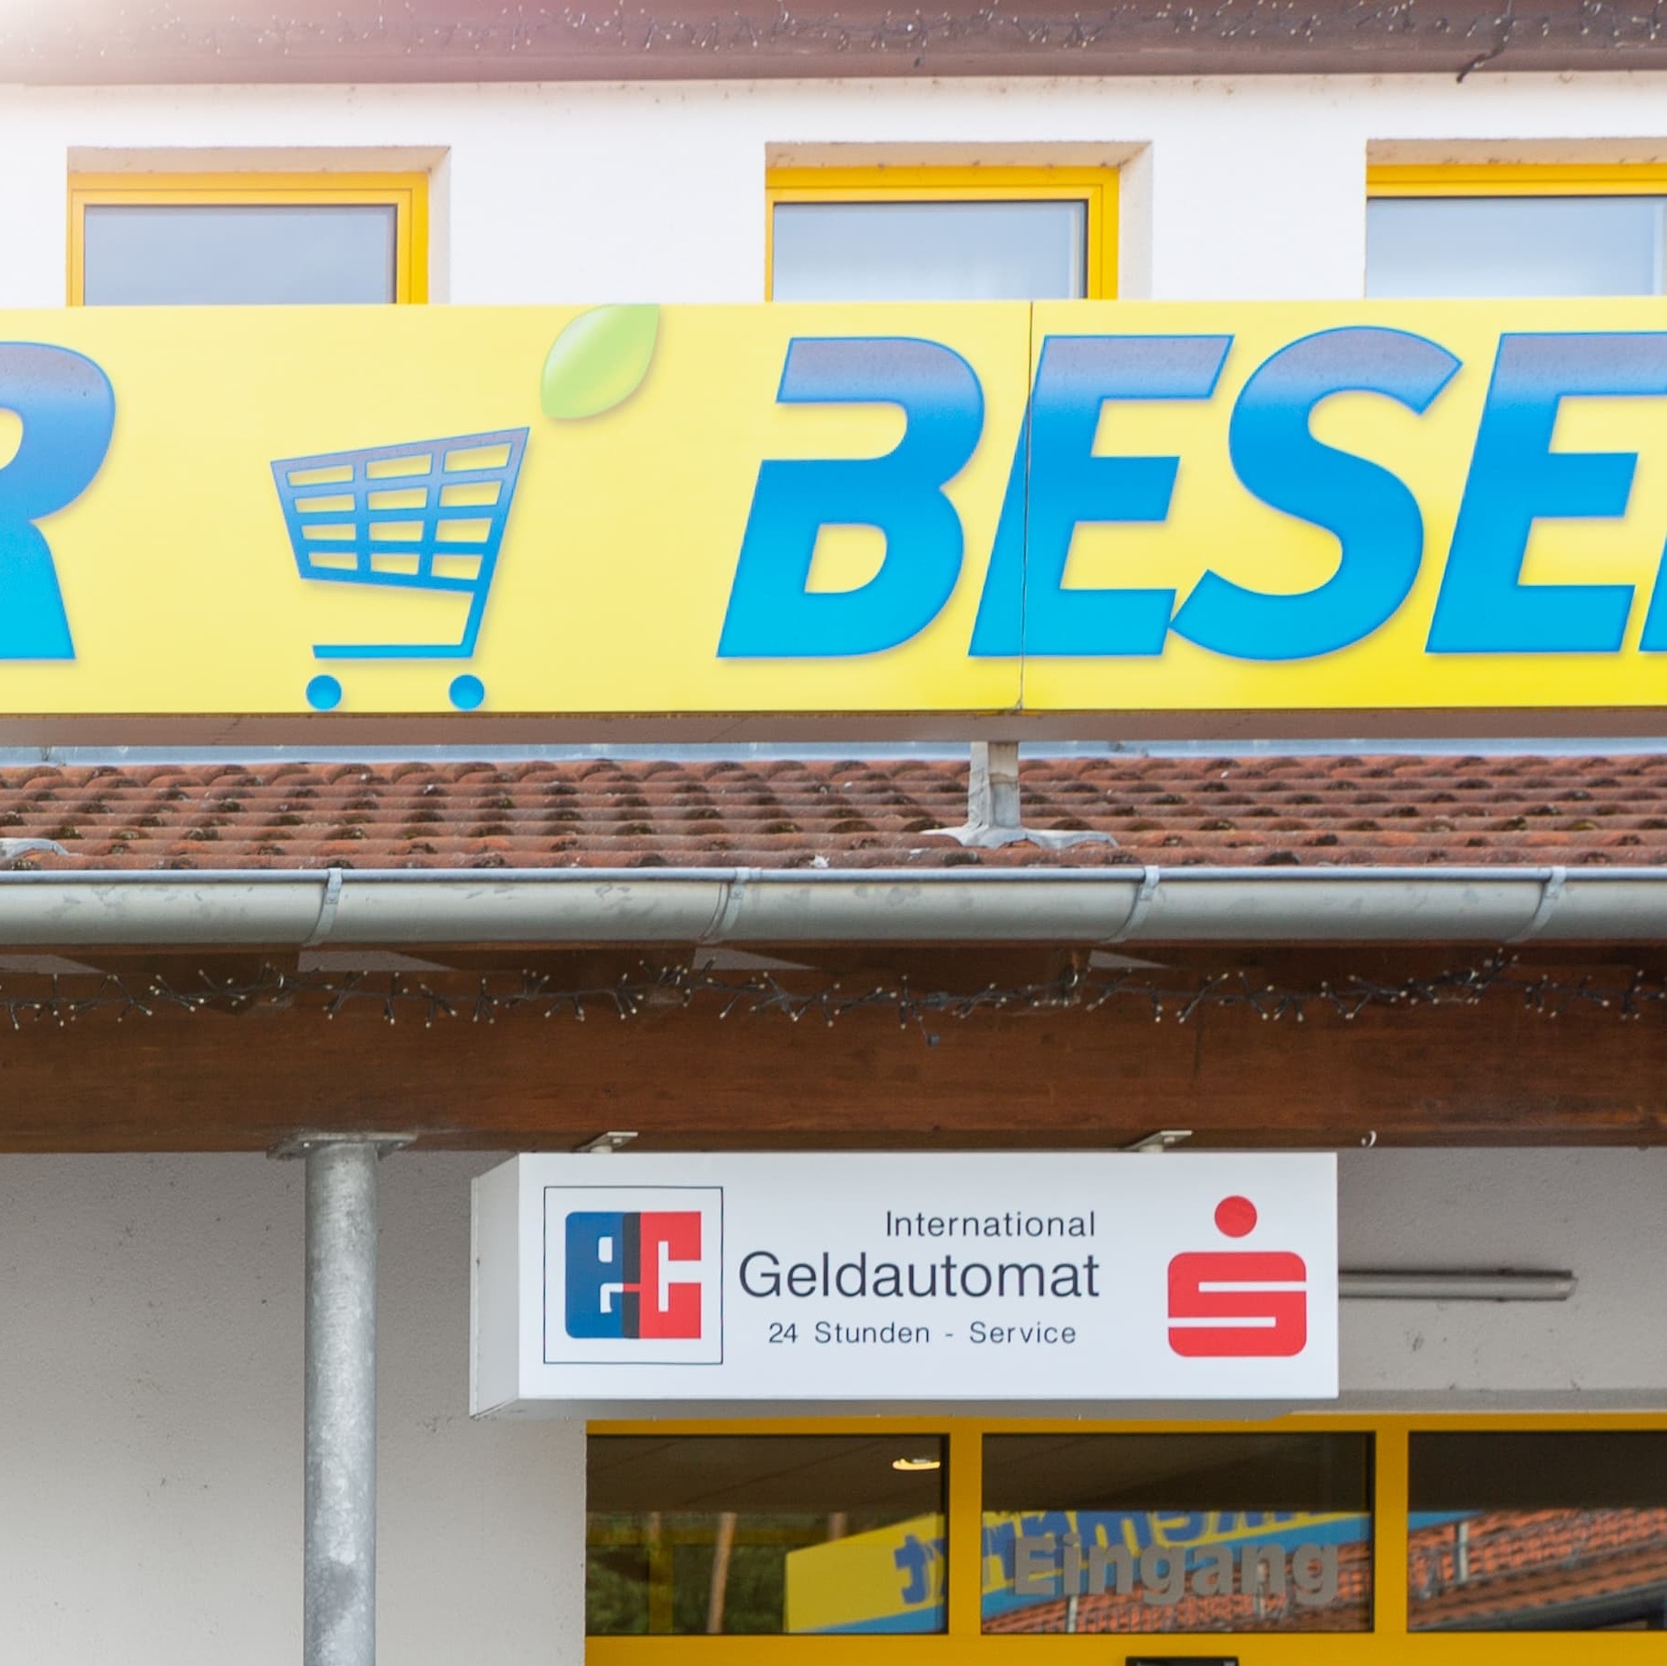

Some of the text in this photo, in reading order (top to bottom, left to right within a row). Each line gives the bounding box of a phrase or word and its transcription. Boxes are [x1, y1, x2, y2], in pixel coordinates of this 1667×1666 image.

[713, 322, 1667, 664] BESE
[885, 1210, 1096, 1238] International
[738, 1250, 1101, 1300] Geldautomat
[768, 1322, 799, 1344] 24
[815, 1321, 931, 1345] Stunden
[969, 1321, 1077, 1345] Service
[1014, 1533, 1339, 1606] Eingang
